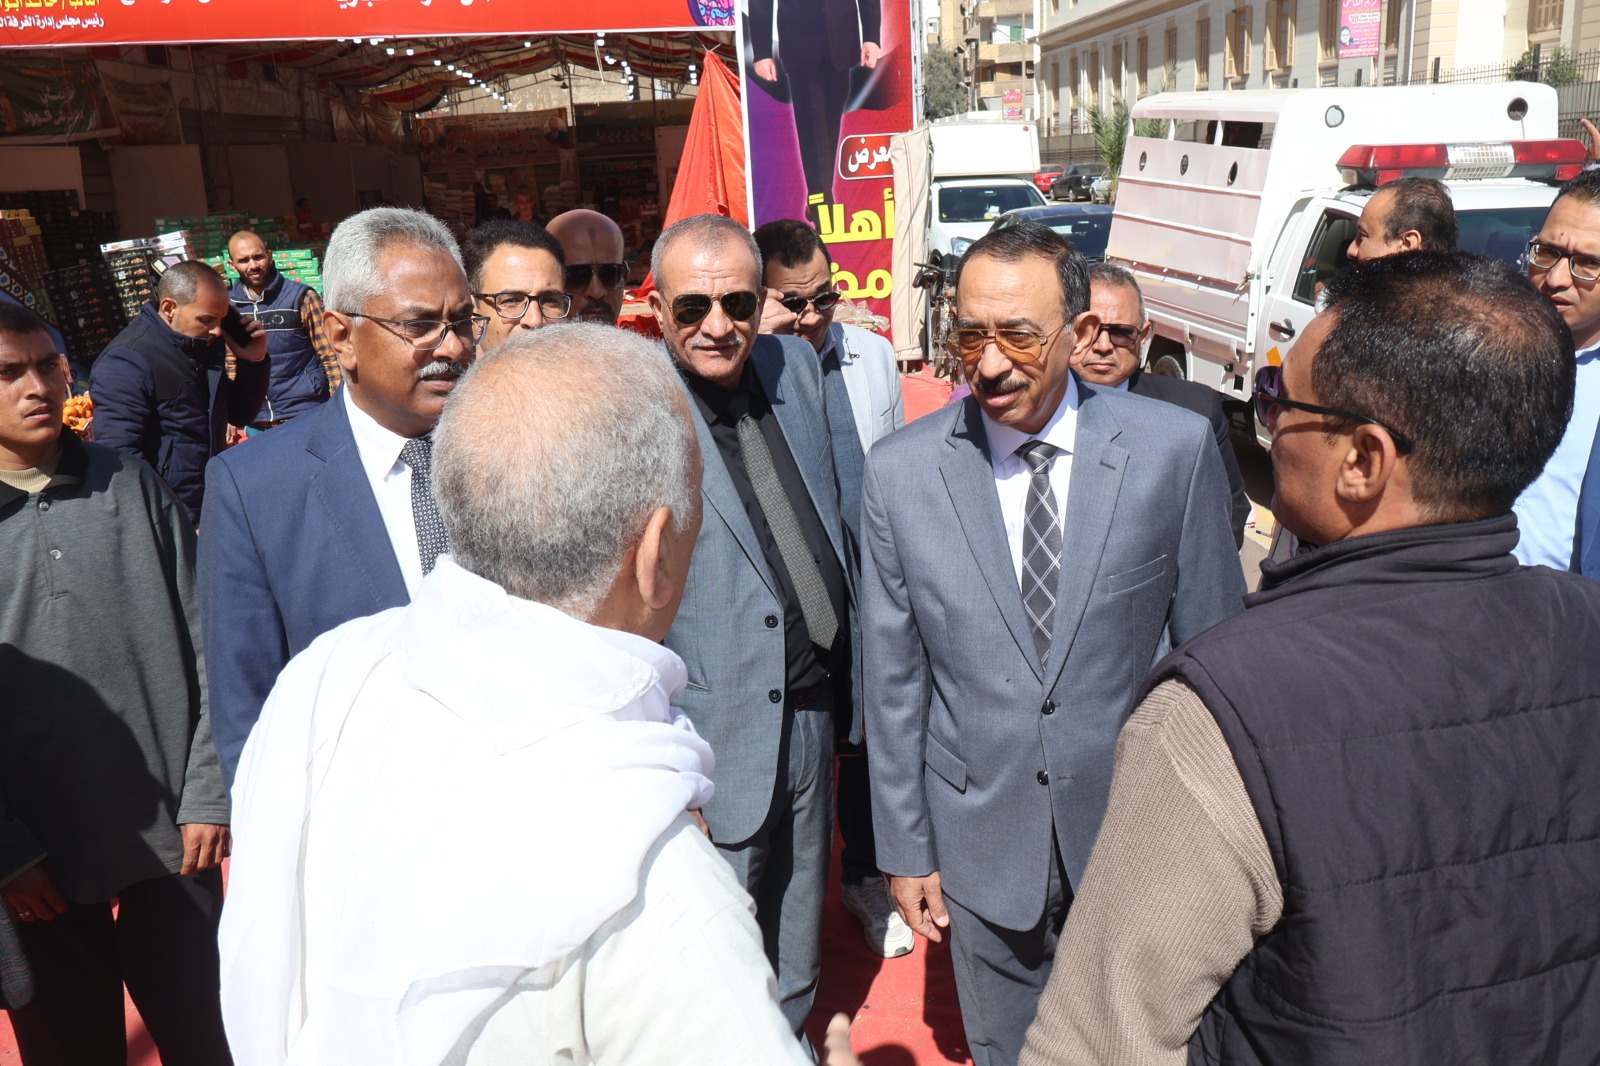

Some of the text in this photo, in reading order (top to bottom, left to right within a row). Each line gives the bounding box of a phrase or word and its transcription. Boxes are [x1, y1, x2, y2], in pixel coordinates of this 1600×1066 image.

[6, 14, 36, 30] الغرفة
[36, 14, 56, 29] إدارة
[56, 15, 81, 29] مجلس
[81, 13, 105, 29] رئيس
[847, 137, 892, 173] عرض
